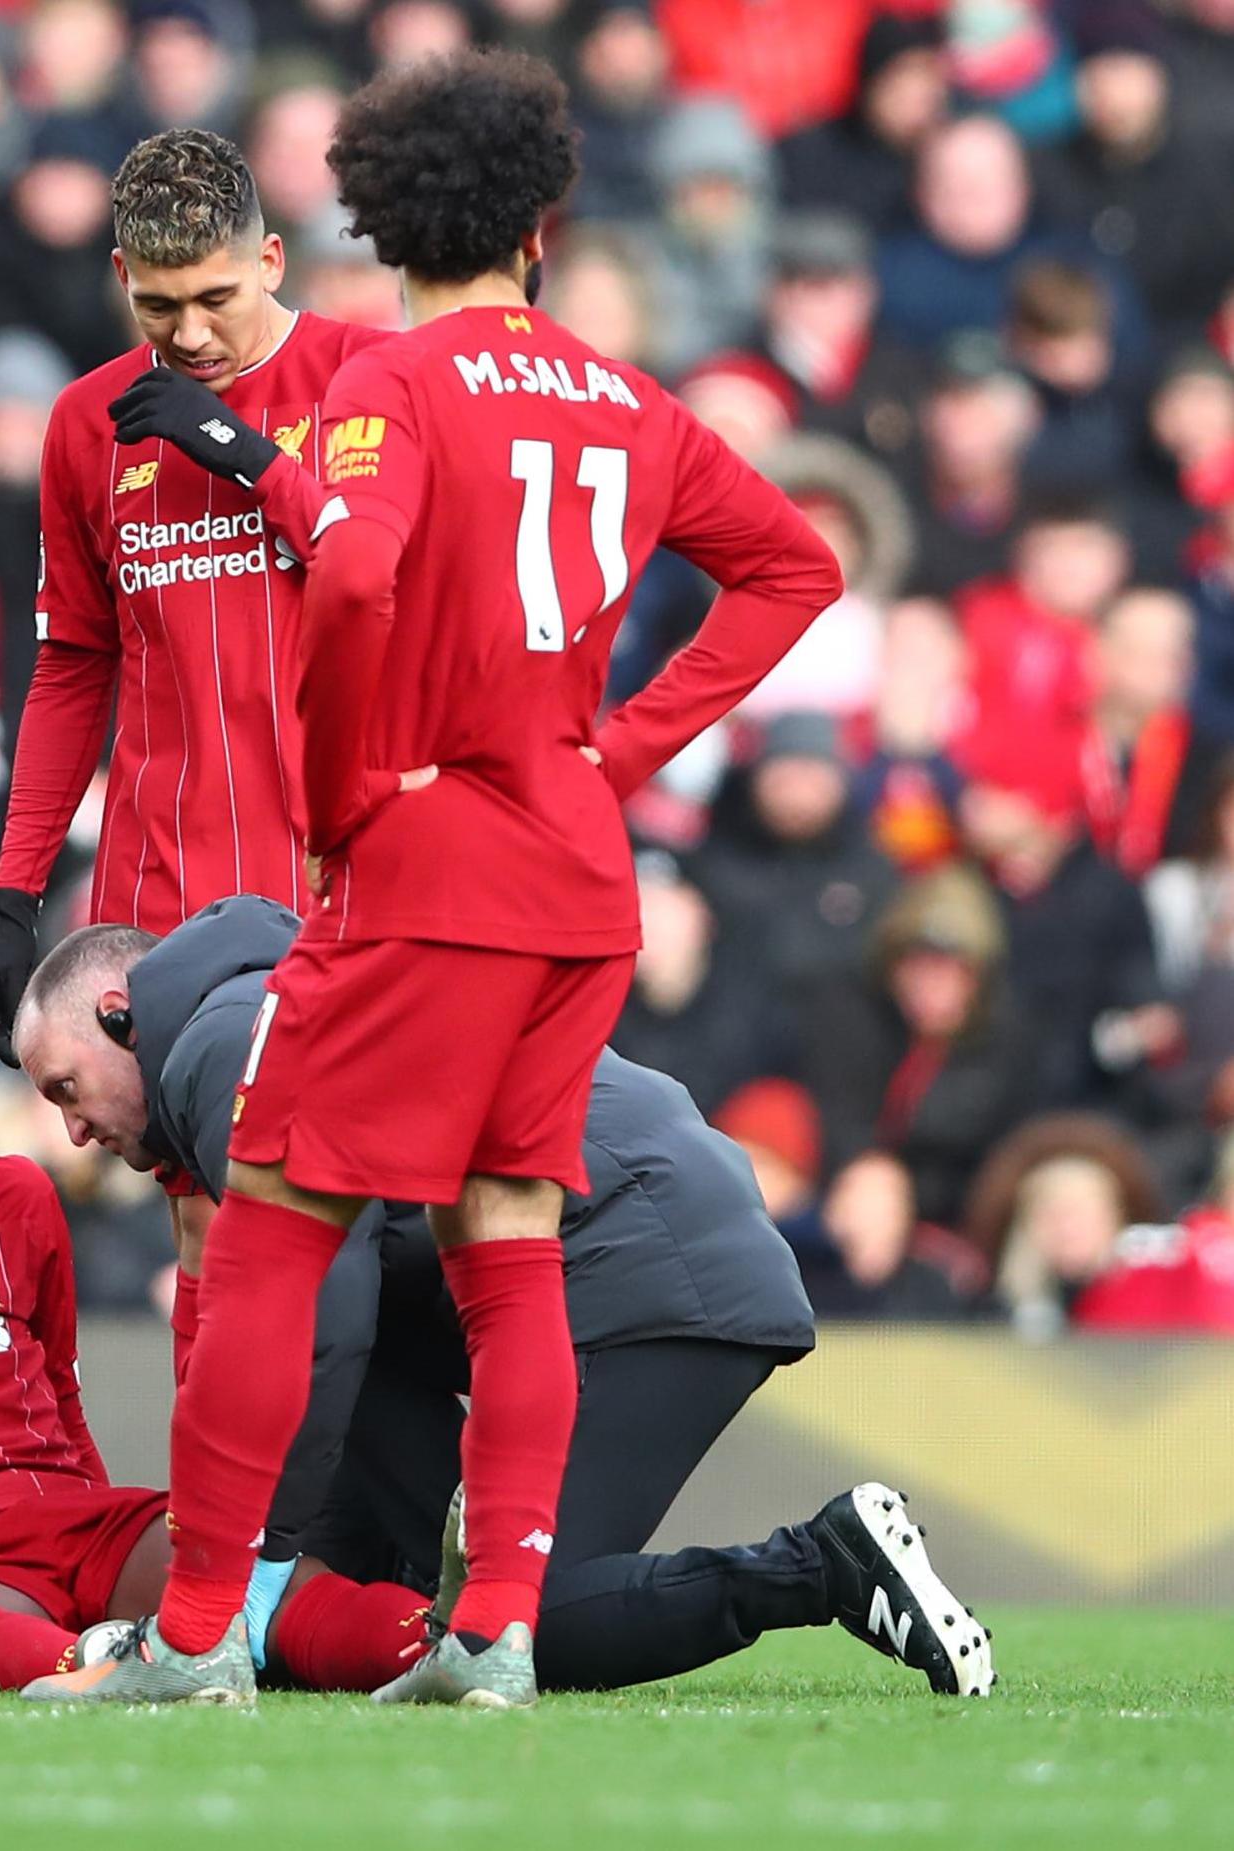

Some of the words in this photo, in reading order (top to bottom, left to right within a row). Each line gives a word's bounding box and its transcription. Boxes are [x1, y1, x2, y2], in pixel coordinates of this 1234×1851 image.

[453, 351, 640, 410] M.SALAH
[120, 505, 263, 554] Standard
[511, 439, 629, 652] 11
[119, 542, 266, 594] Chartered
